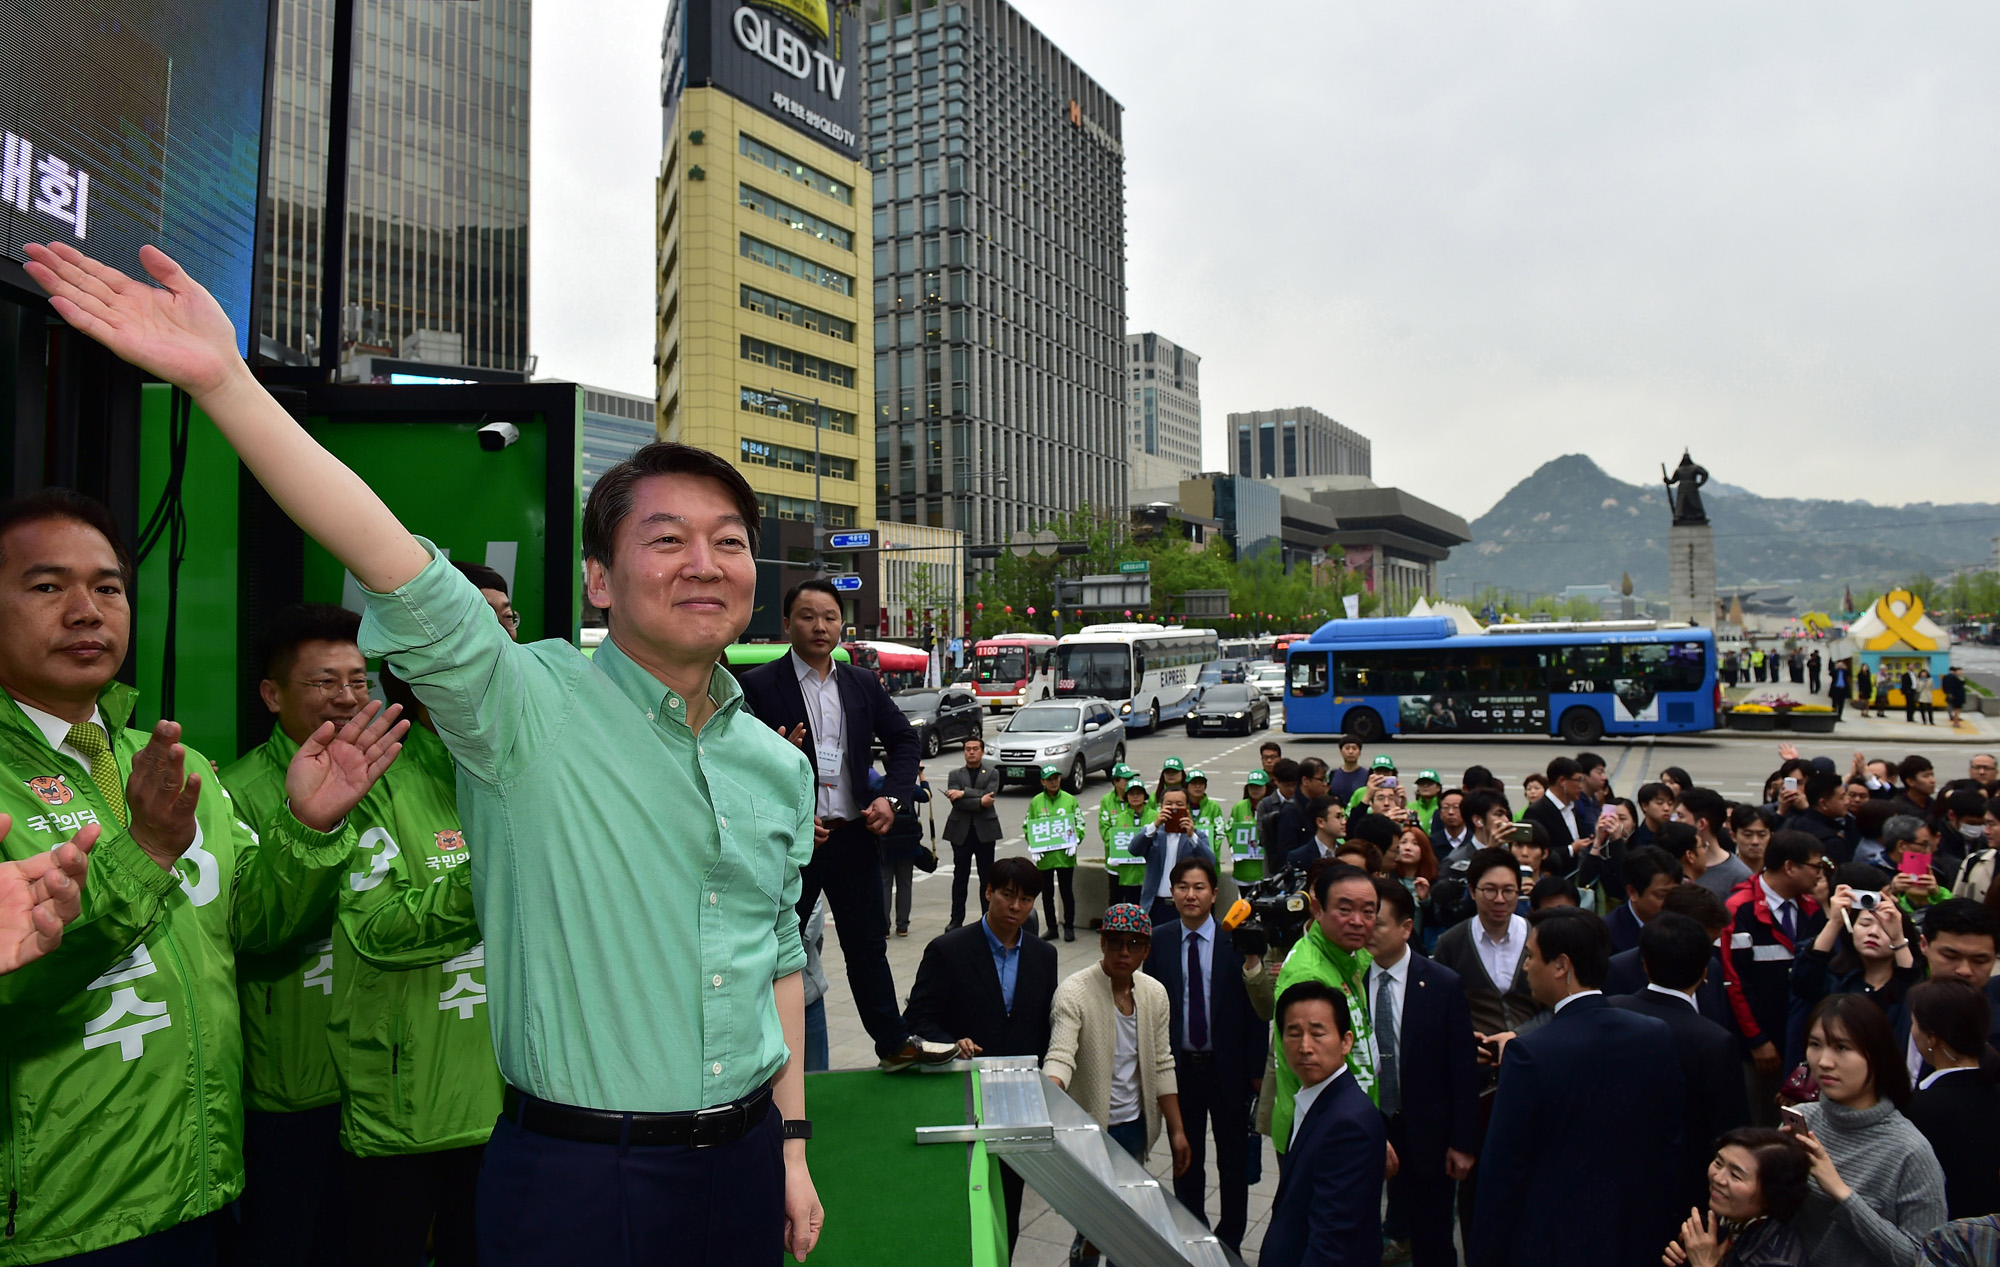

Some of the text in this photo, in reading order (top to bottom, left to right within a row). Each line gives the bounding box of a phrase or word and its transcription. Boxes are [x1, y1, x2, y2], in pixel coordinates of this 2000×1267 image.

[734, 6, 811, 79] QLED
[813, 50, 846, 100] TV
[820, 117, 844, 141] QLED
[843, 129, 855, 147] TV
[979, 646, 998, 655] 1100
[1160, 668, 1187, 688] EXPRESS
[1569, 680, 1594, 692] 470
[1032, 818, 1072, 843] 변화
[350, 827, 400, 891] 3
